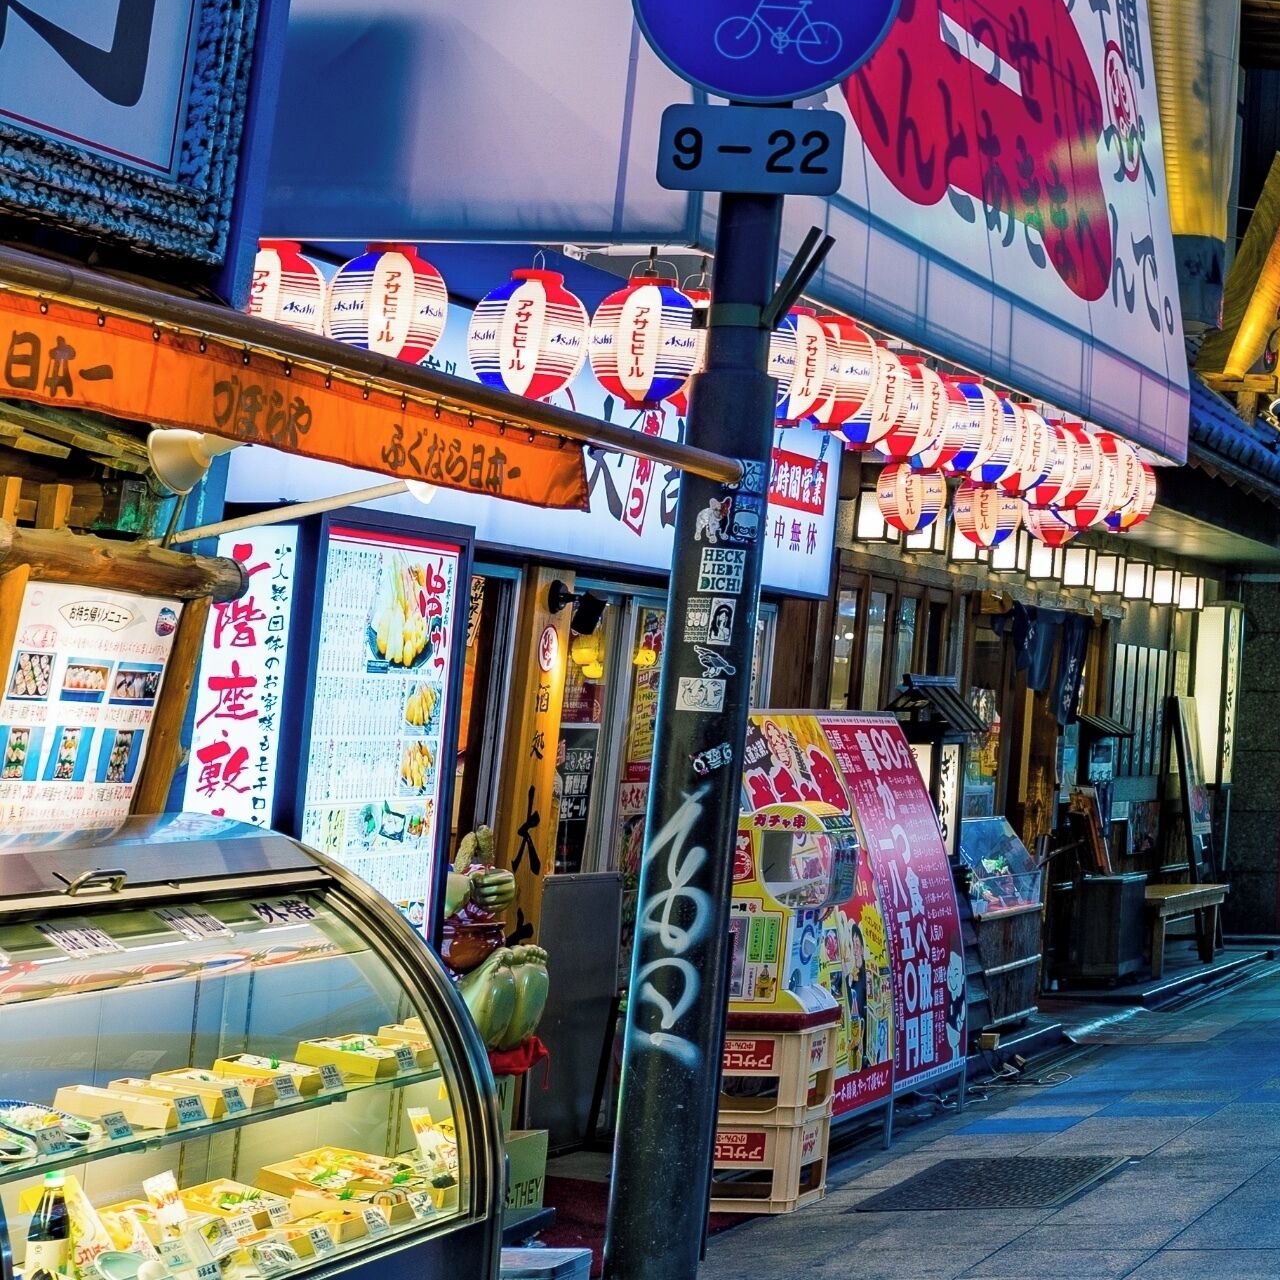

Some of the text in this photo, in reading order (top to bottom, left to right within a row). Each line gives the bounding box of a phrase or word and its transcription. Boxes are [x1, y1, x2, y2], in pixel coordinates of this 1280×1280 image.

[377, 270, 402, 343] アサヒビール
[508, 299, 534, 371] アサヒビール
[4, 330, 114, 397] 日本一
[626, 306, 651, 379] アサヒビール
[381, 423, 522, 494] ふぐなら日本一
[700, 577, 741, 592] DICH!
[702, 564, 743, 577] LIEBT
[703, 550, 744, 564] HECK
